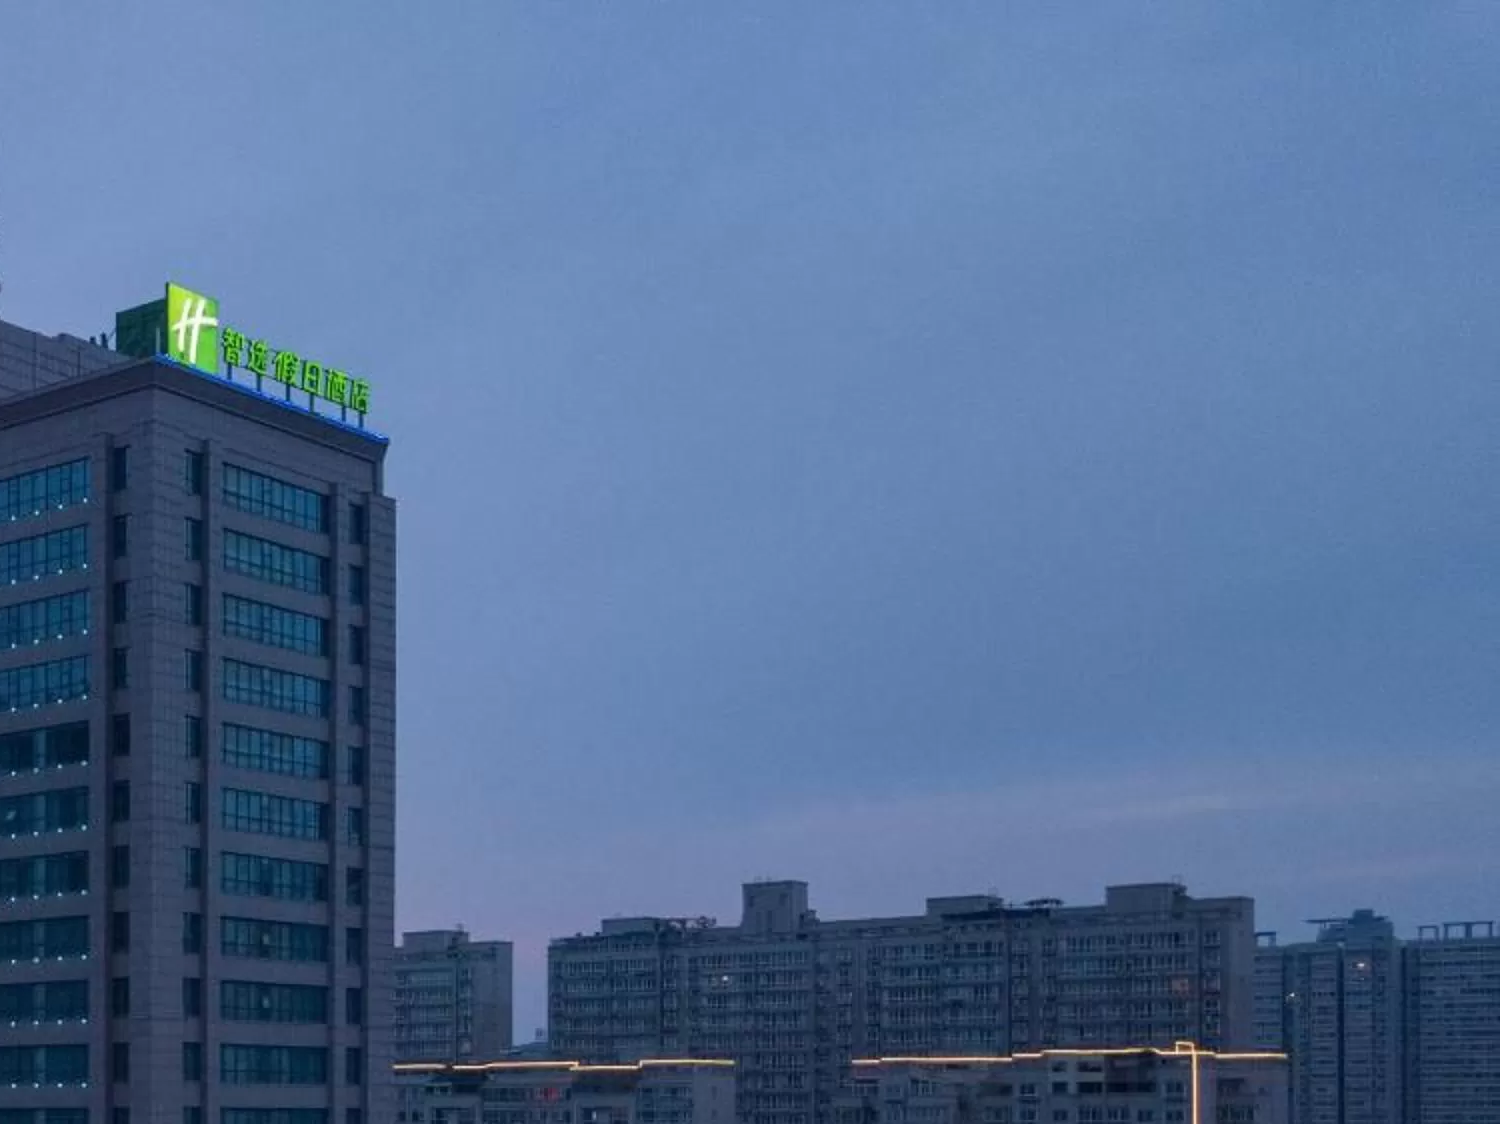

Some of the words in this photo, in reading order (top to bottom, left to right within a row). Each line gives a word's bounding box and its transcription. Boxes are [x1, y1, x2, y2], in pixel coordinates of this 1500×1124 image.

[222, 328, 370, 415] 智选假日酒店
